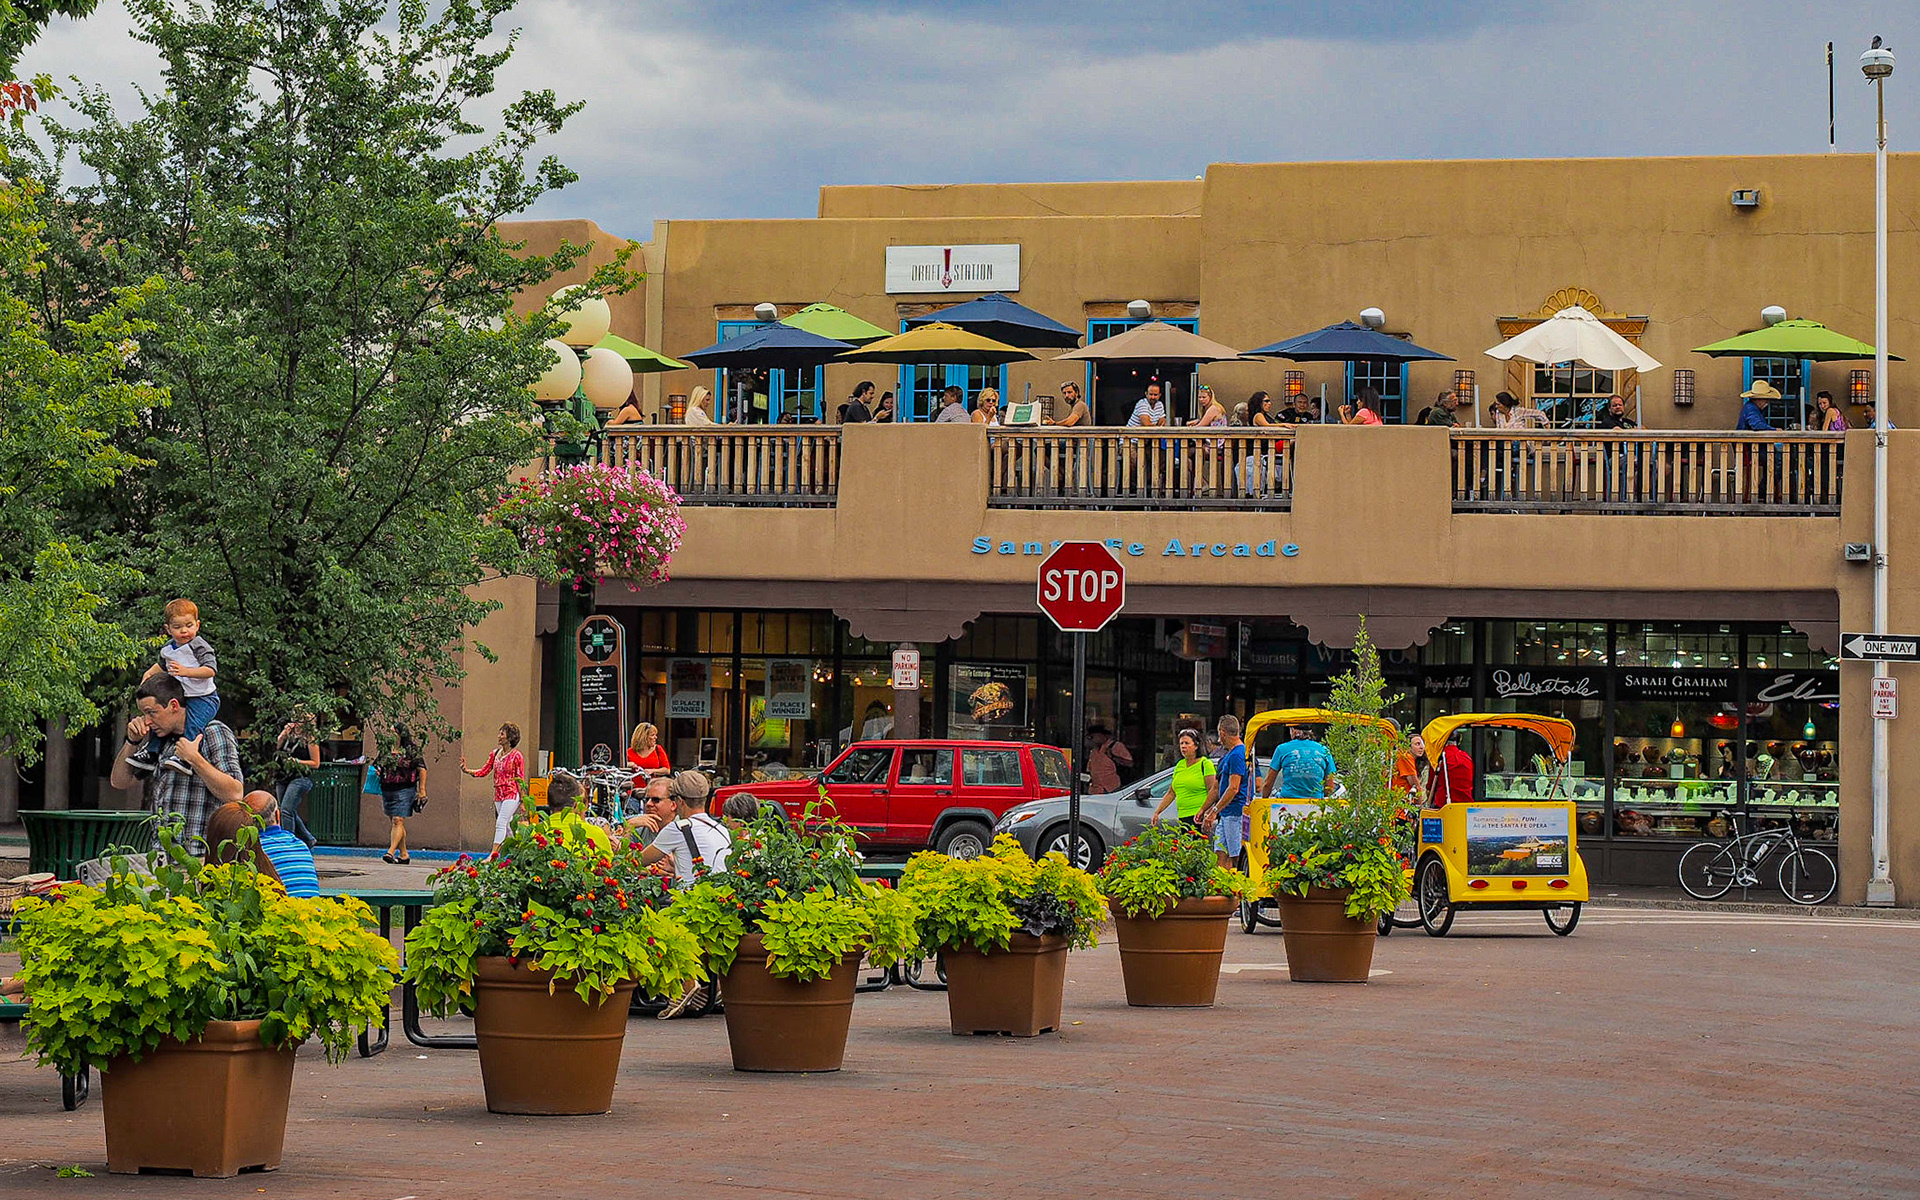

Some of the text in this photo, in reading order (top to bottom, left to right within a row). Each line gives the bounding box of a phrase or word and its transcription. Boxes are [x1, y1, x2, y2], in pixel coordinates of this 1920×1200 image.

[911, 263, 993, 281] DRAFT STATION
[1162, 538, 1300, 557] Arcade
[1043, 568, 1119, 602] STOP
[1864, 641, 1913, 654] ONE WAY
[901, 654, 912, 662] NO
[1231, 650, 1298, 665] Rtaurants
[894, 662, 917, 670] PARKING
[1492, 669, 1537, 694] Belle
[1625, 674, 1728, 688] SARAH GRAHAM
[1879, 681, 1890, 689] NO
[1873, 690, 1897, 698] PARKING
